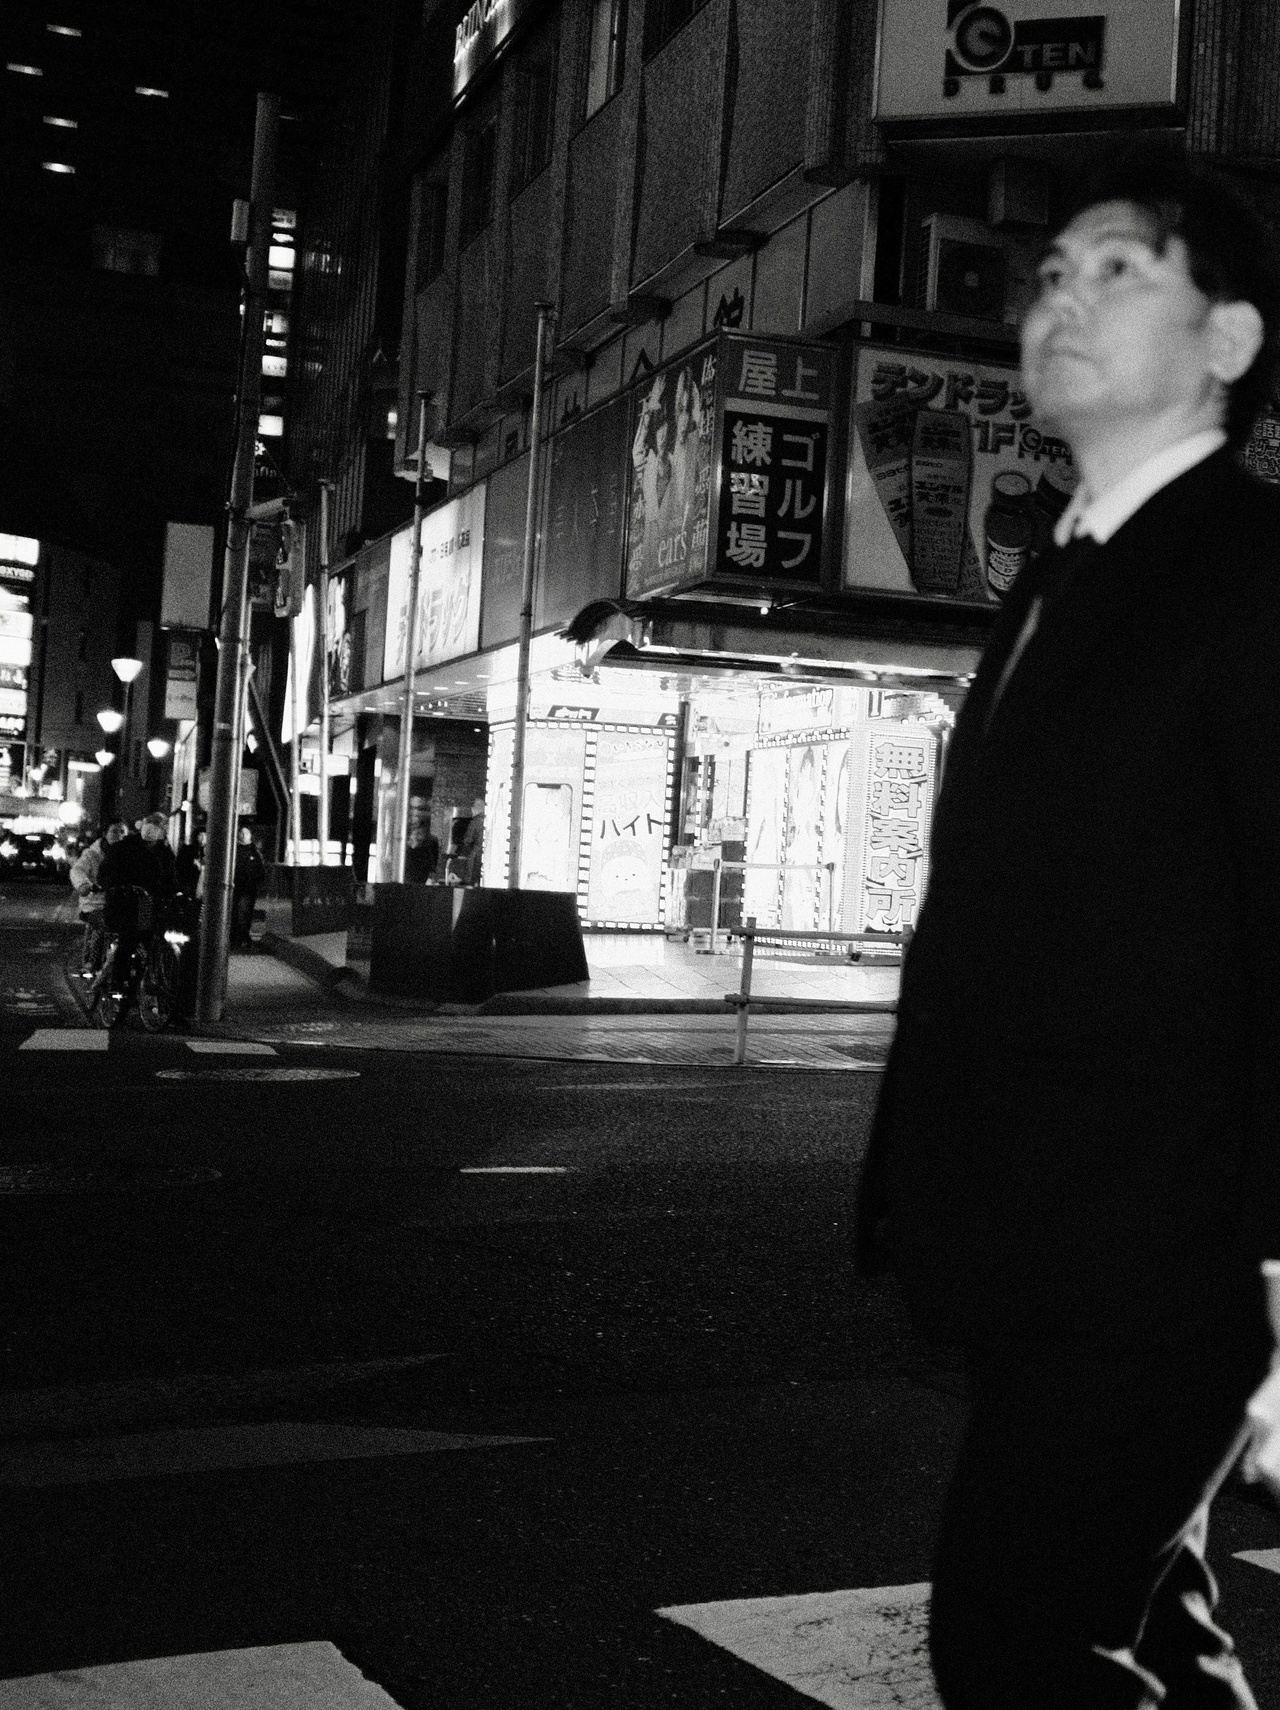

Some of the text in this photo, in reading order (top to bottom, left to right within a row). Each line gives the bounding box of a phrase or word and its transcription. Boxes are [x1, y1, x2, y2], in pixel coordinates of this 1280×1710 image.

[1017, 42, 1098, 68] TEN
[738, 349, 820, 400] 屋上
[725, 419, 774, 569] 練習場
[777, 431, 822, 569] ゴルフ
[866, 742, 928, 922] 無料案内所
